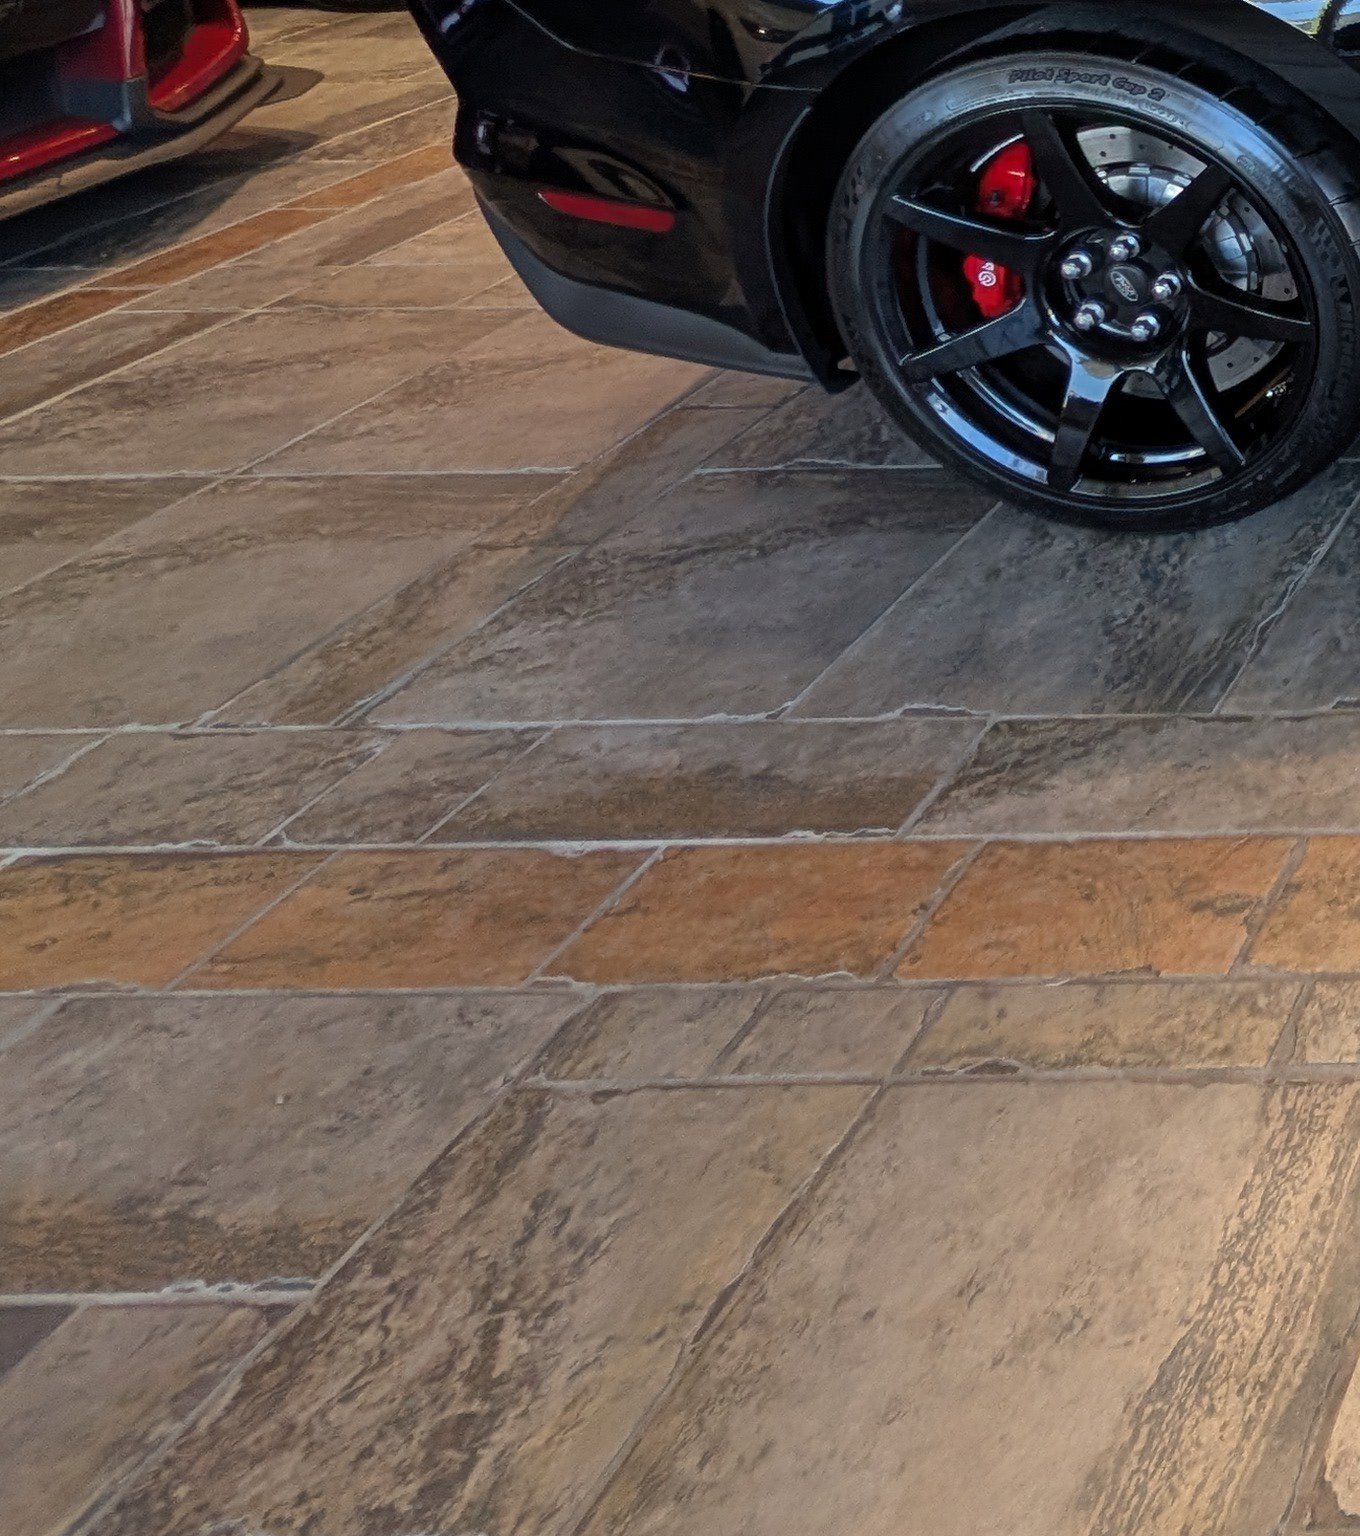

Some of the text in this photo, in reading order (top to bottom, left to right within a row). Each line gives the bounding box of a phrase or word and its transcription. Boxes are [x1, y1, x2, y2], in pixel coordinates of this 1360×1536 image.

[1008, 67, 1167, 102] Pilot Sport Cup 2
